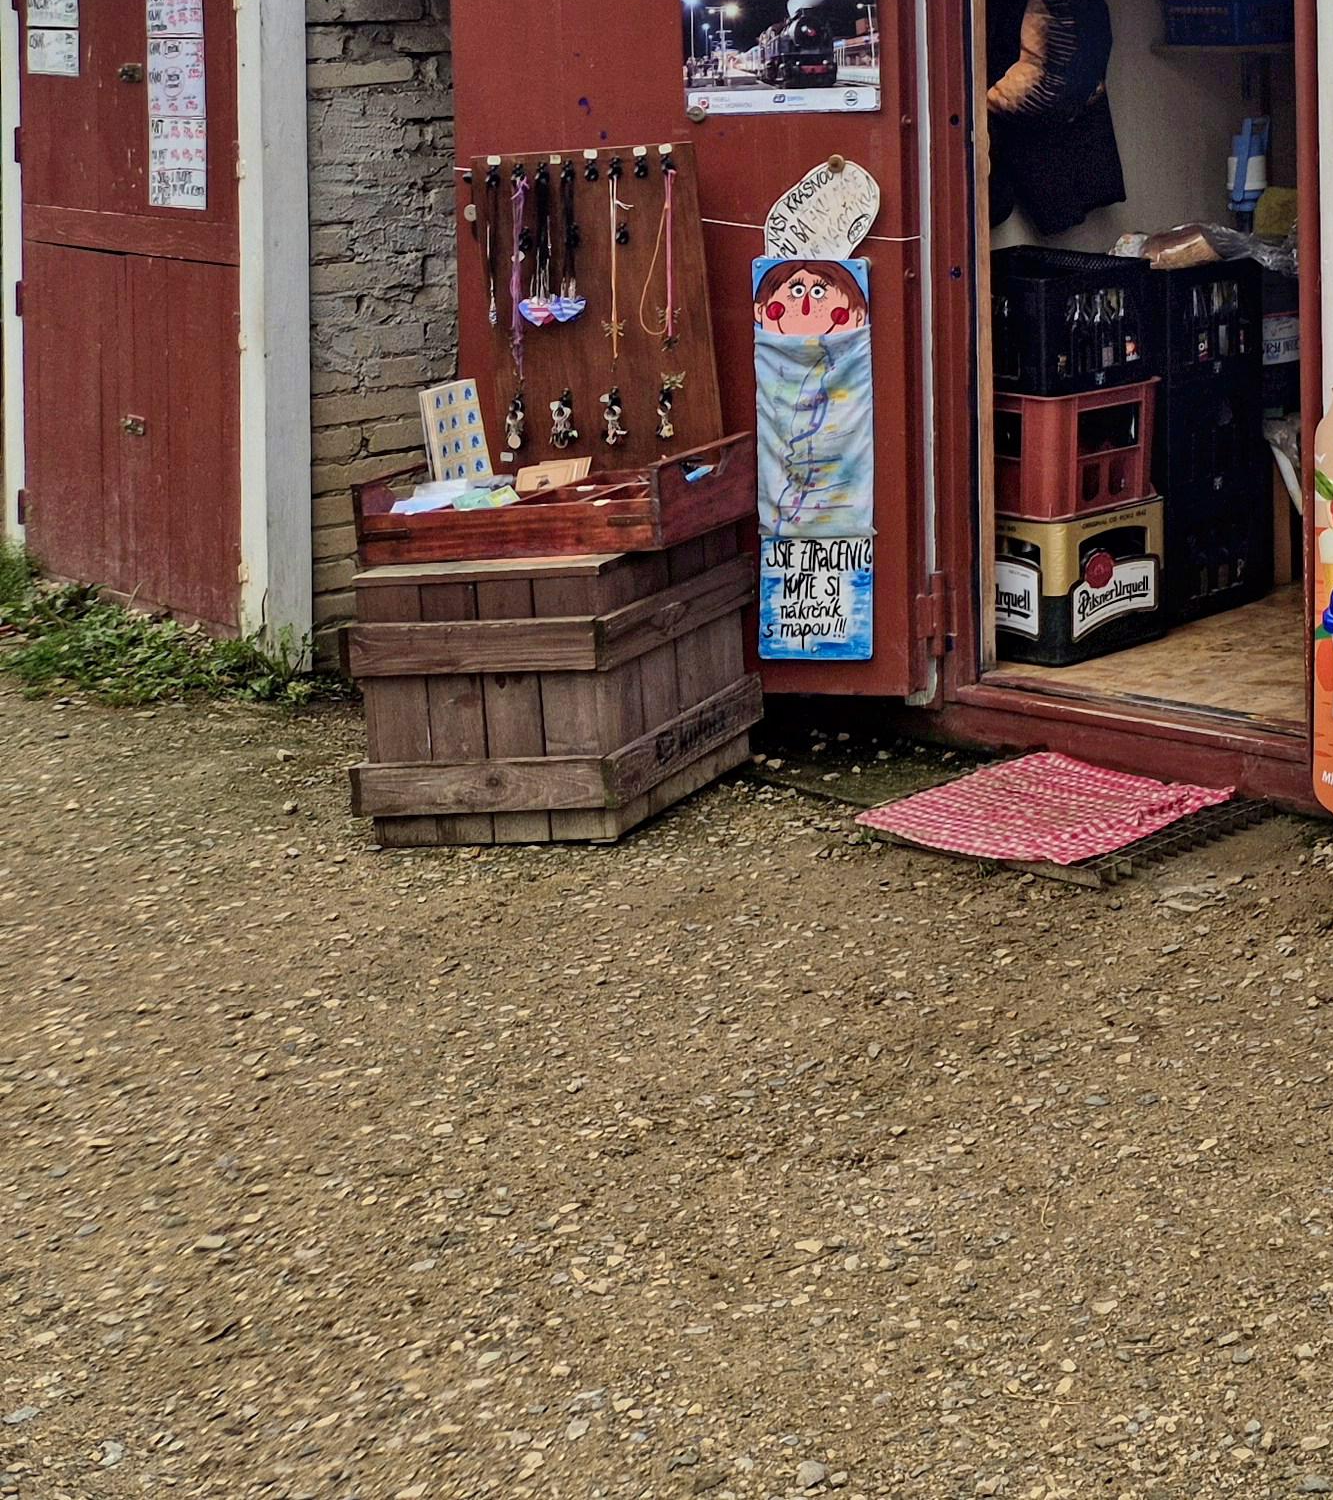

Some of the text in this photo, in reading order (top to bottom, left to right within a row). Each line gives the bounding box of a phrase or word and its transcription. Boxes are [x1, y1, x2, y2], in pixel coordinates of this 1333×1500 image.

[766, 540, 796, 570] JSTE
[783, 572, 841, 600] KUPTE SI
[1078, 575, 1150, 623] Pilsner Urquell
[780, 597, 843, 619] nákrčník
[763, 623, 774, 638] s
